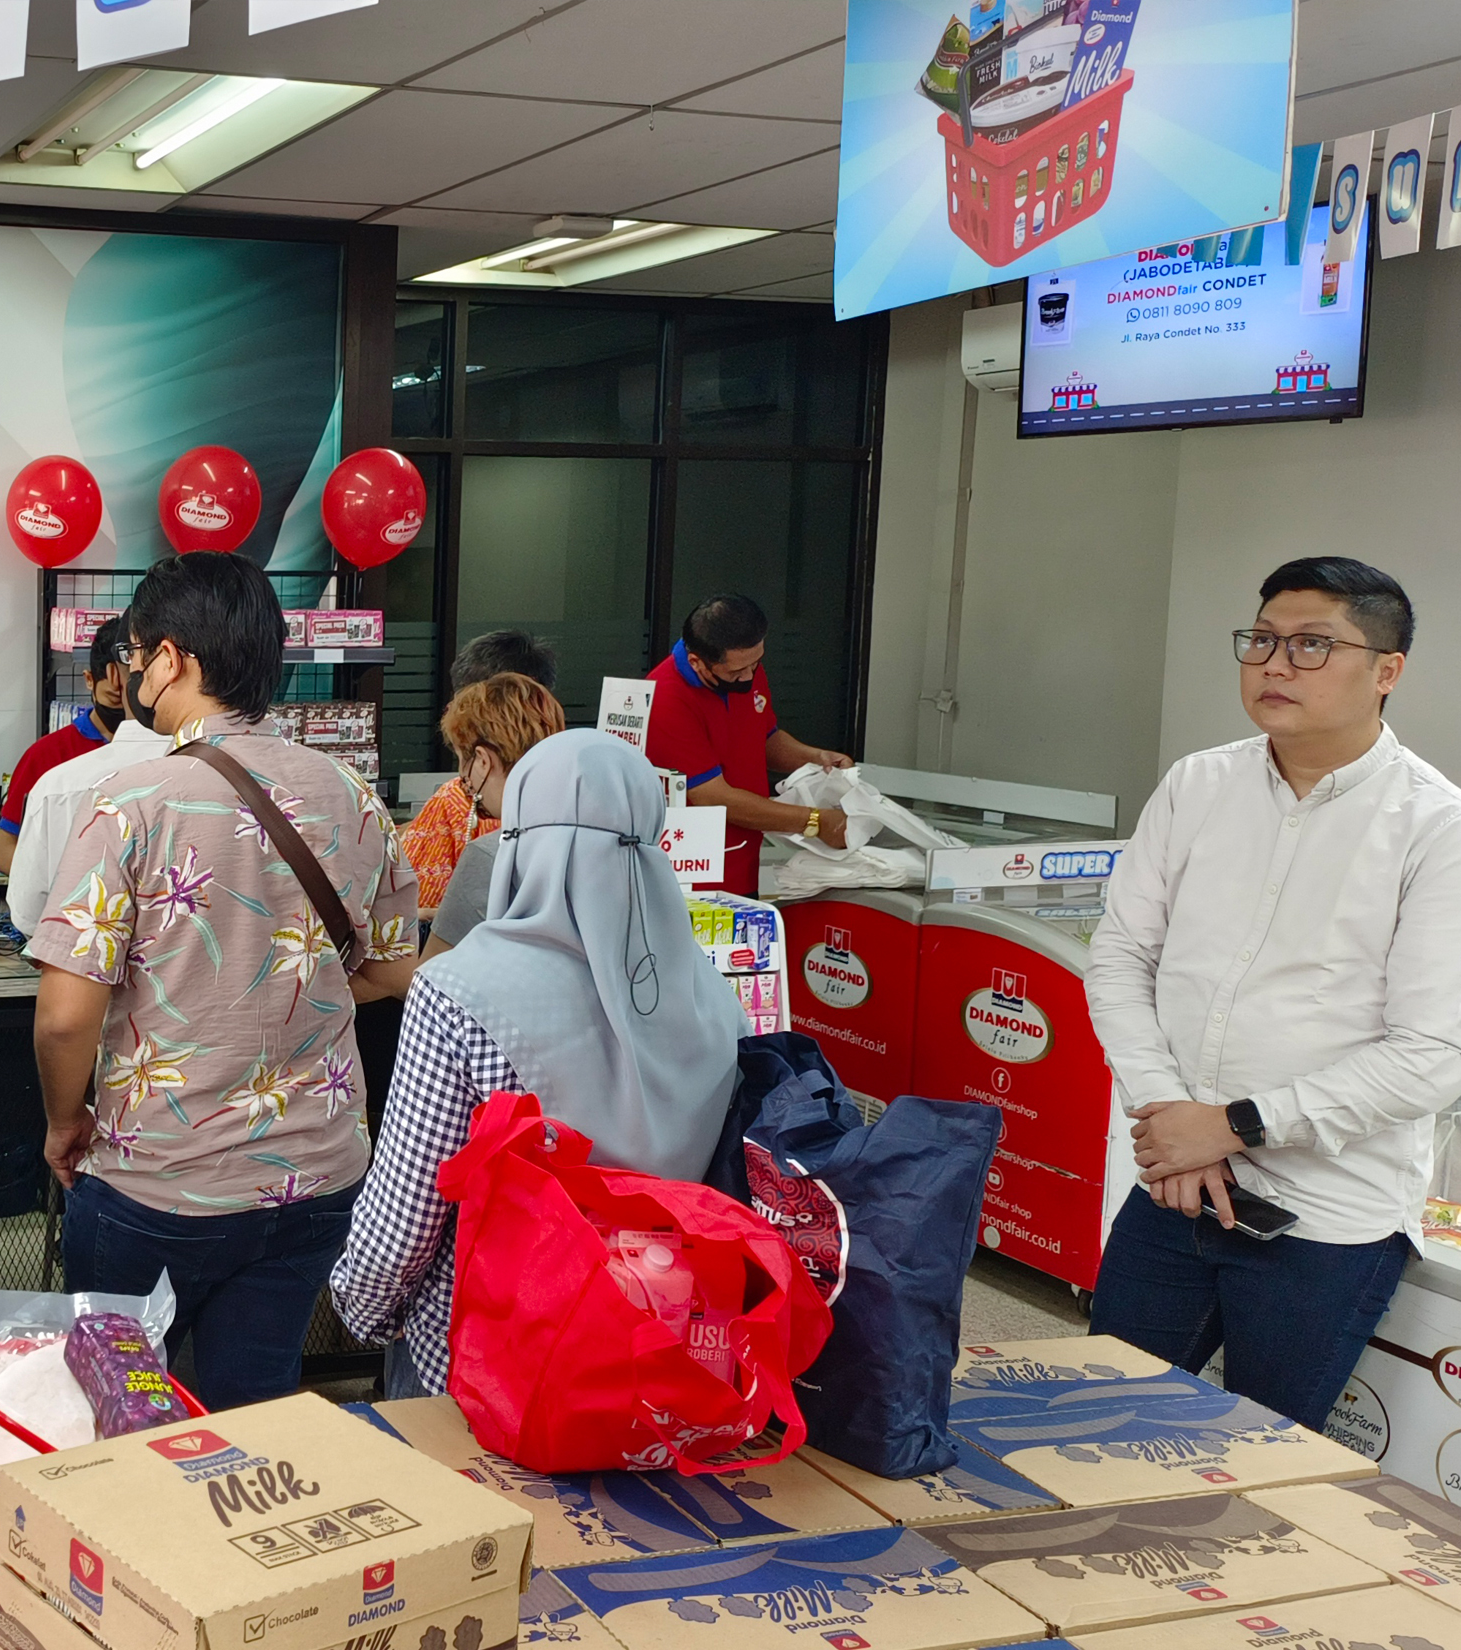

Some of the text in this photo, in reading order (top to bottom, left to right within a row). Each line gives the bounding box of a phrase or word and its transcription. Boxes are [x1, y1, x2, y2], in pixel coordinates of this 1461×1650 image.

[1090, 10, 1133, 24] Diamond
[976, 62, 1001, 78] FRESH
[978, 71, 998, 85] MILK
[1064, 41, 1123, 107] Milk
[1107, 273, 1267, 304] DIAMONDfair CONDET
[1142, 297, 1242, 320] 0811 8090 809
[1135, 333, 1160, 344] Raya
[1163, 327, 1202, 339] Condet
[1225, 322, 1246, 332] 333
[20, 514, 61, 530] DIAMOND
[181, 506, 227, 521] DIAMOND
[670, 859, 710, 872] URNI
[1040, 851, 1112, 880] SUPER
[807, 960, 865, 987] DIAMOND
[824, 979, 845, 995] fair
[791, 1013, 887, 1054] ww.diamondfair.co.id
[969, 1006, 1044, 1038] DIAMOND
[990, 1029, 1018, 1047] fair
[964, 1085, 1038, 1120] DIAMONDfairshop
[984, 1192, 1032, 1220] NDfair shop
[980, 1211, 1061, 1254] mondfair.co.id
[690, 1324, 730, 1350] USU
[687, 1348, 725, 1361] ROBERI
[970, 1356, 1032, 1365] Diamond
[127, 1371, 162, 1383] JUICE
[996, 1362, 1059, 1387] Milk
[125, 1381, 173, 1394] JUNGLE
[1331, 1406, 1382, 1436] rookFarm
[1126, 1433, 1197, 1463] Milk
[66, 1457, 114, 1473] Chocolate
[182, 1457, 270, 1484] DIAMOND
[183, 1450, 242, 1470] Diamond
[1159, 1456, 1228, 1471] Diamond
[469, 1456, 514, 1491] Diamond
[207, 1460, 321, 1528] Milk
[249, 1534, 278, 1549] 9
[1111, 1542, 1189, 1579] Milk
[1150, 1571, 1225, 1589] Diamond
[71, 1581, 102, 1612] Diamond
[753, 1580, 832, 1623] Milk
[268, 1605, 319, 1628] Chocolate
[348, 1599, 405, 1627] DIAMOND
[784, 1615, 867, 1634] Diamond
[1246, 1628, 1324, 1648] Diamond
